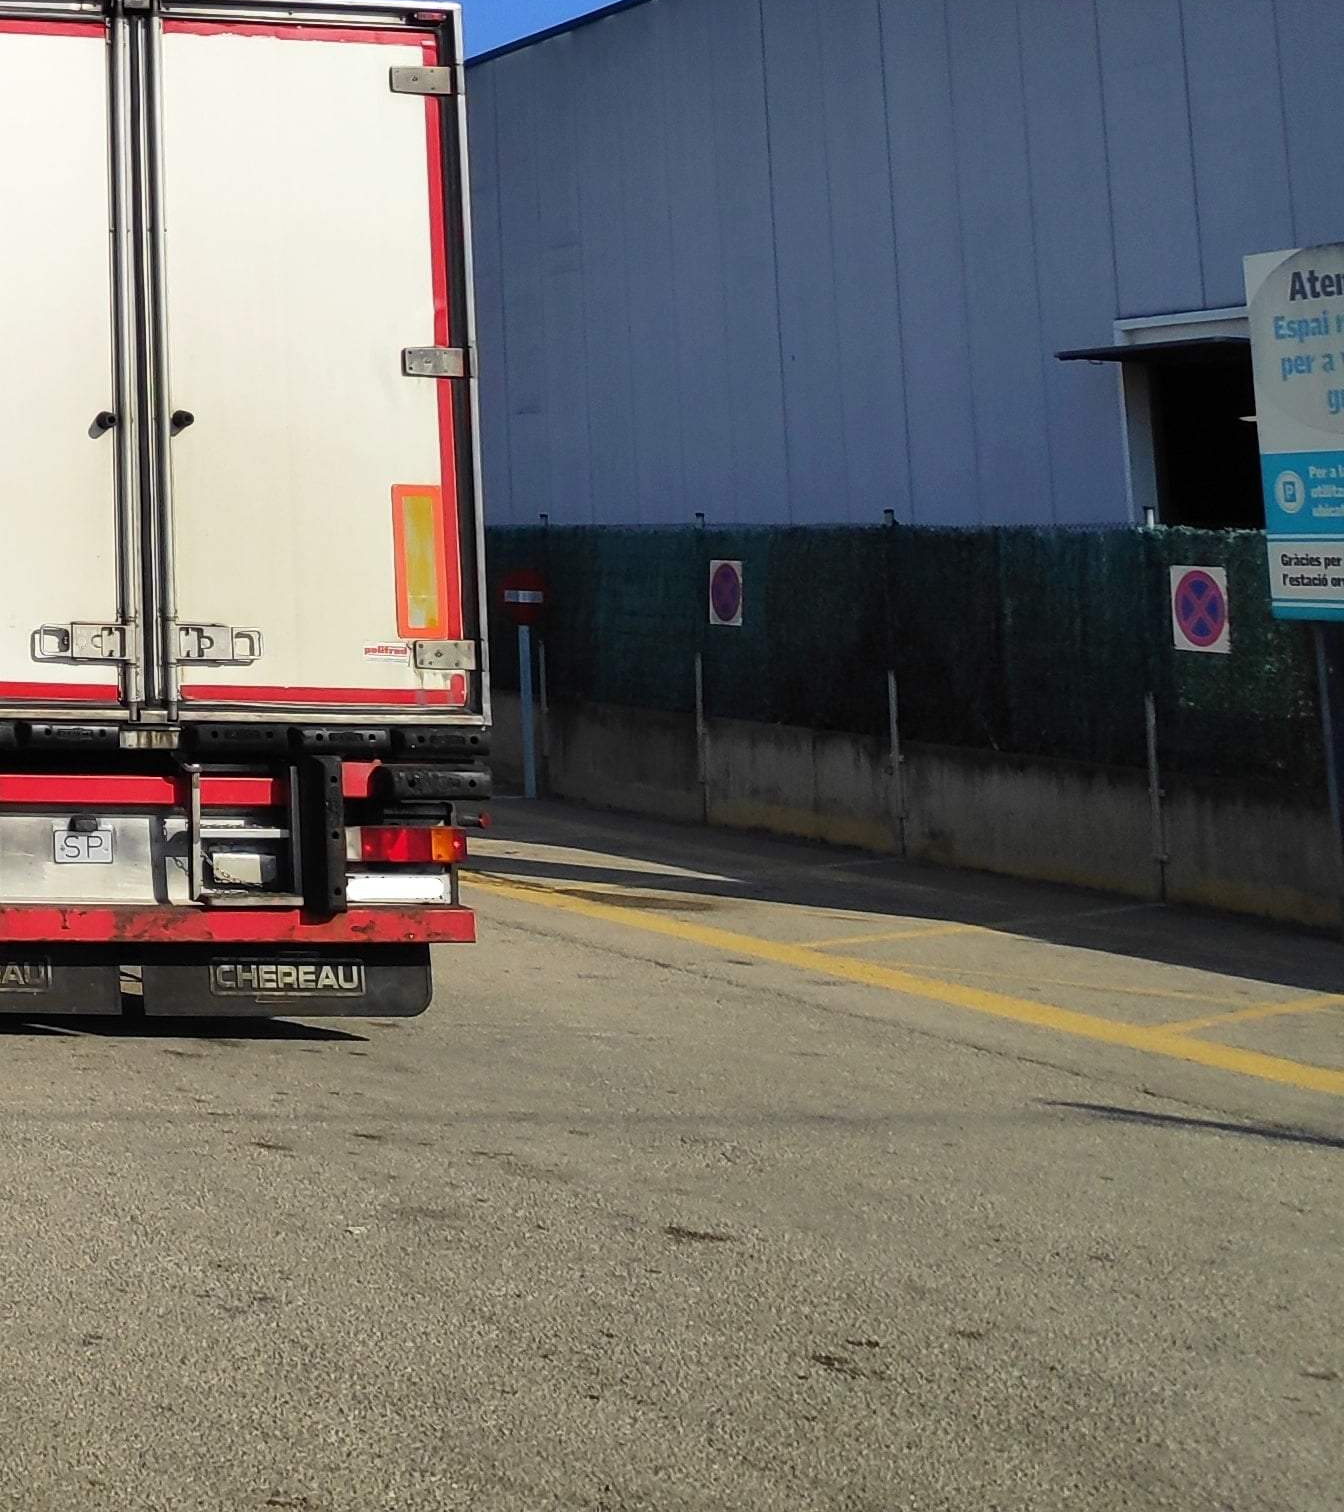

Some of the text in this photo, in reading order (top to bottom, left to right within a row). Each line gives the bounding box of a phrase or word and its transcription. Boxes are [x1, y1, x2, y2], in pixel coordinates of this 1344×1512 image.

[1273, 310, 1329, 342] Espai
[1281, 353, 1334, 381] per a
[1281, 553, 1342, 569] Gràcies per
[1282, 573, 1328, 587] l'estació
[63, 835, 104, 859] SP
[216, 964, 360, 989] CHEREAU
